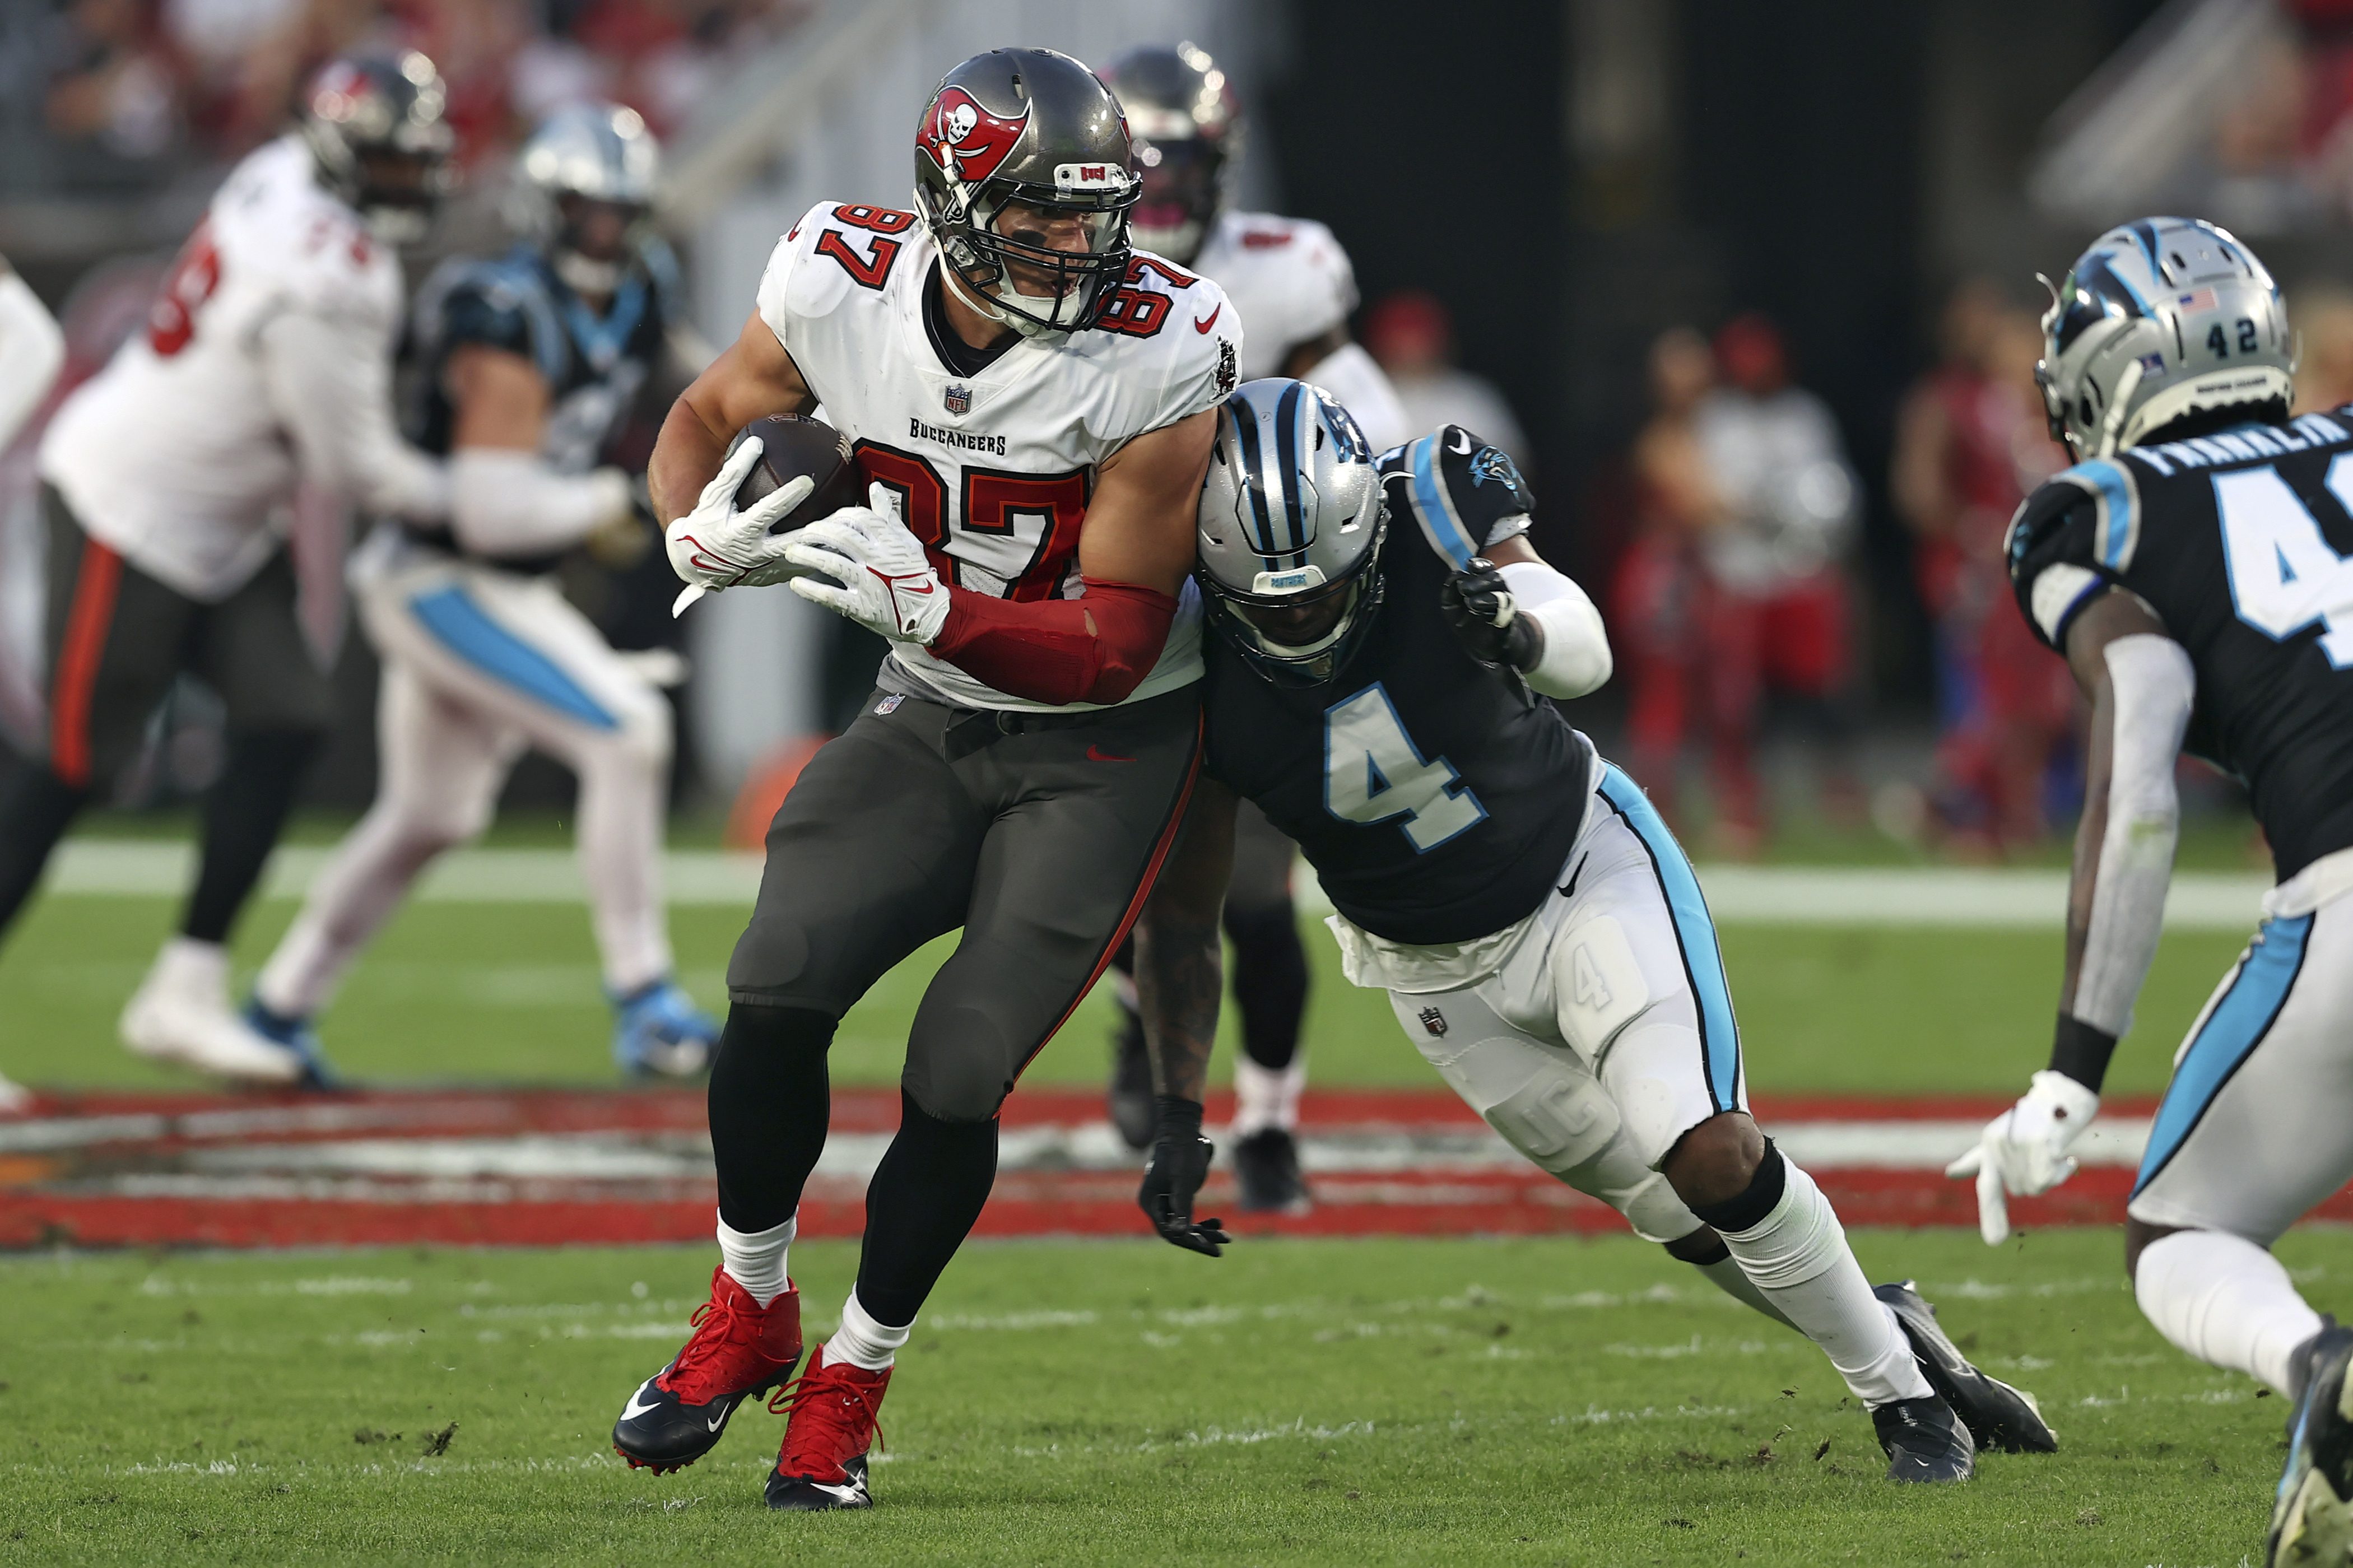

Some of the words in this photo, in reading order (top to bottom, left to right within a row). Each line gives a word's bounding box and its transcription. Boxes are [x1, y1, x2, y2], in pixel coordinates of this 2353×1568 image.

[814, 204, 919, 291] 87
[2207, 318, 2258, 359] 42
[947, 397, 965, 411] NFL
[910, 417, 1006, 457] BUCCANEERS
[1324, 681, 1490, 855] 4
[1573, 942, 1613, 1012] 4
